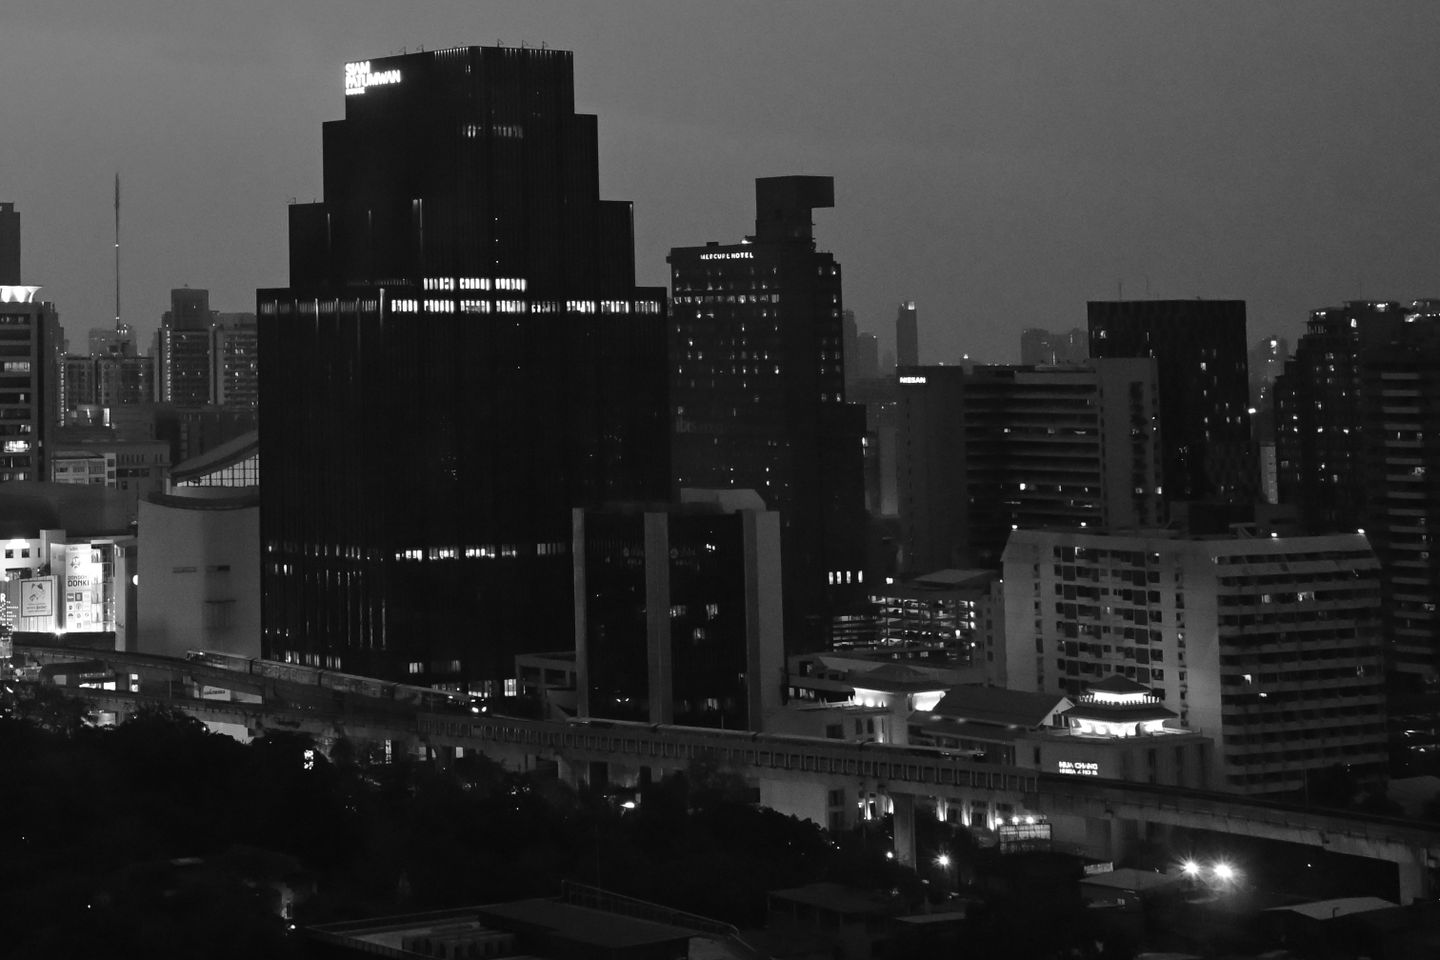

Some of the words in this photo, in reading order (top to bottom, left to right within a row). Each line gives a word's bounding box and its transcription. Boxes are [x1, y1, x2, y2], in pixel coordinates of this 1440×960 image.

[345, 60, 371, 75] SIAM
[345, 69, 401, 89] PATUMWAN
[899, 376, 927, 384] NISSAN
[67, 580, 90, 588] DONKI
